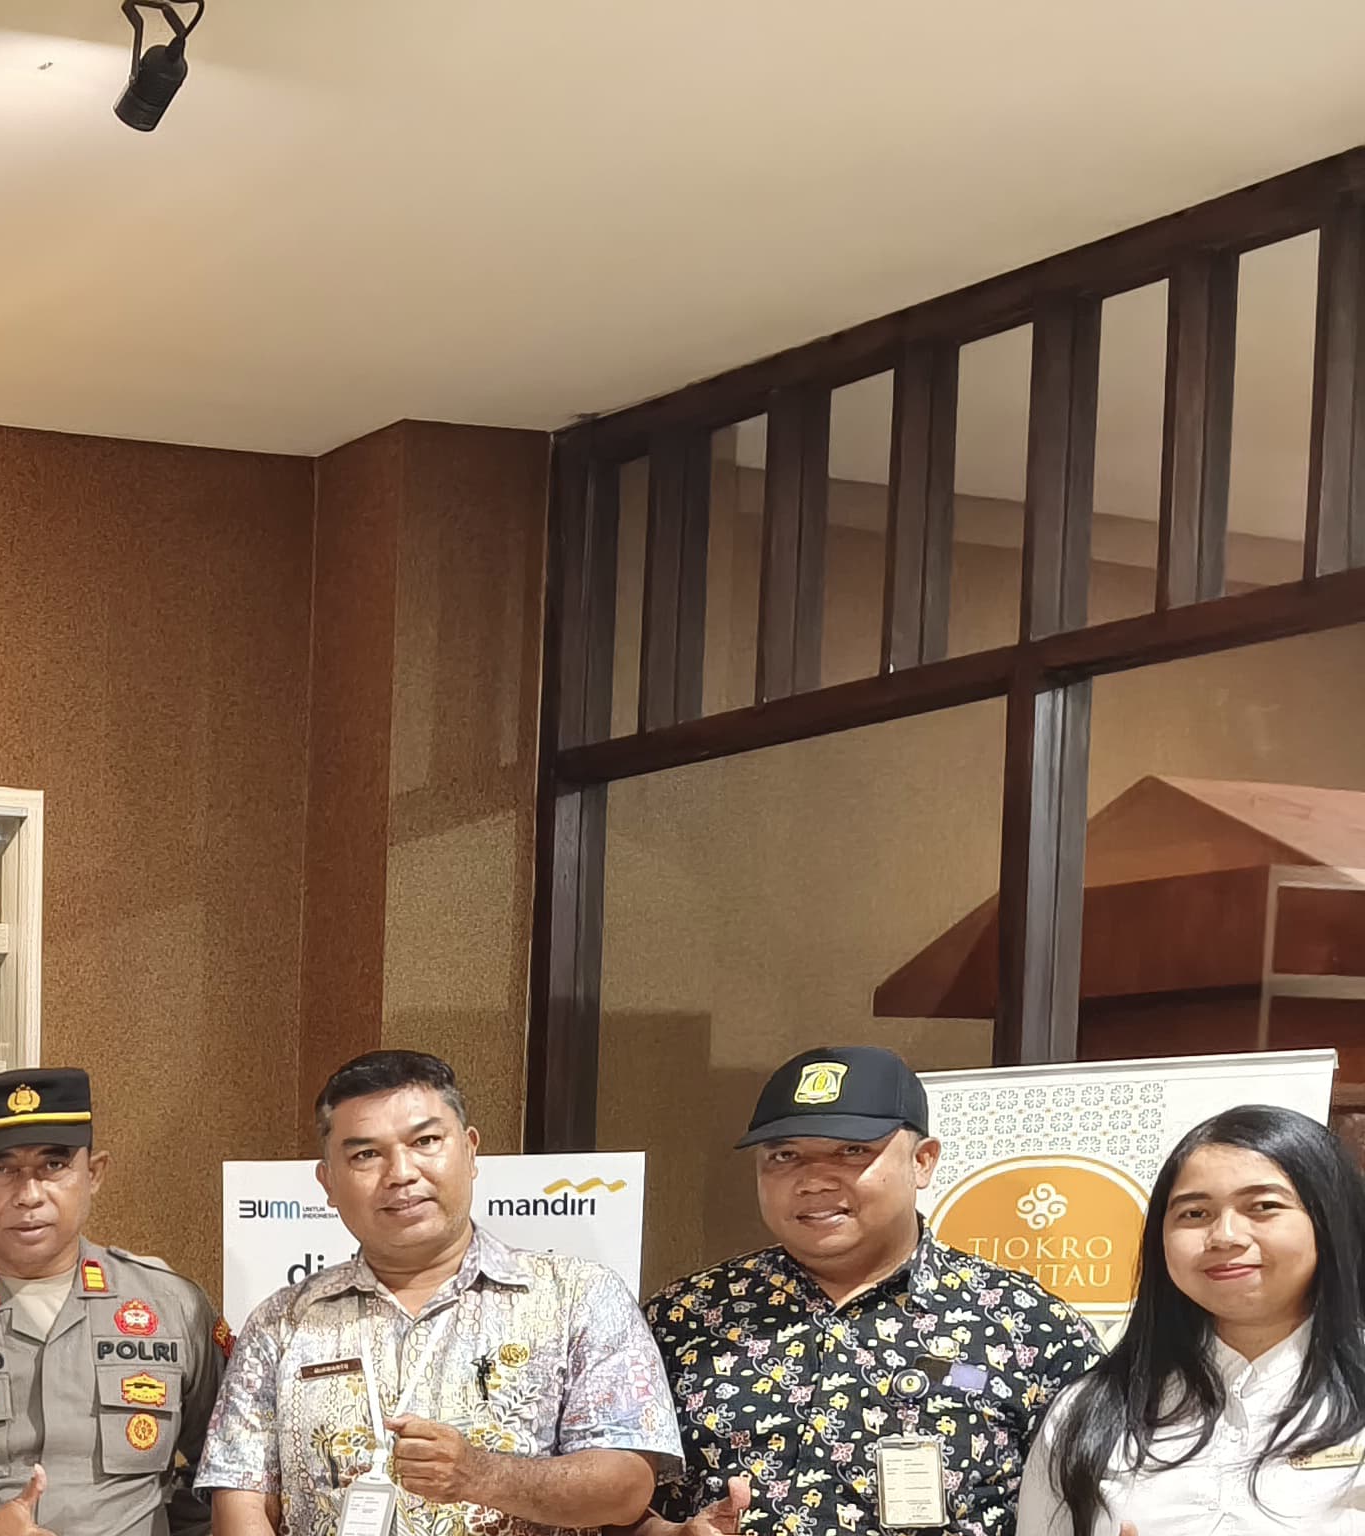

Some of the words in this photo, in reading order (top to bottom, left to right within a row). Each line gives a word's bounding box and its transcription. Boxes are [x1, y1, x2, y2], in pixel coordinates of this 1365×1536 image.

[488, 1192, 596, 1216] mandiri
[968, 1236, 1113, 1262] TJOKRO
[97, 1340, 178, 1362] POLRI
